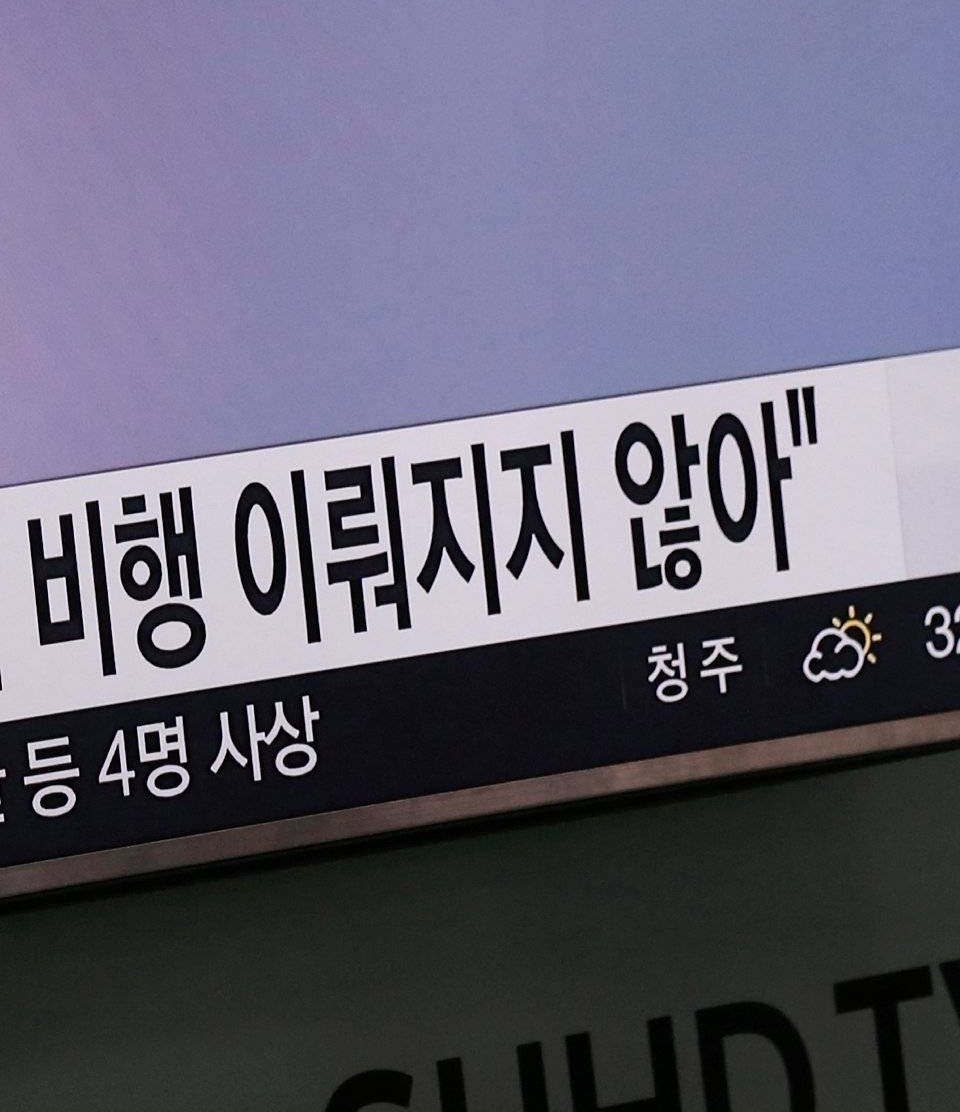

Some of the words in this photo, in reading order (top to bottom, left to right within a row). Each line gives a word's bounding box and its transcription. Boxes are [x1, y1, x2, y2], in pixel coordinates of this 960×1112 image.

[28, 486, 207, 677] 비행
[234, 429, 591, 644] 이뤄지지
[614, 385, 818, 591] 않아"
[23, 736, 80, 817] 등
[98, 715, 190, 798] 4명
[210, 695, 320, 782] 사상
